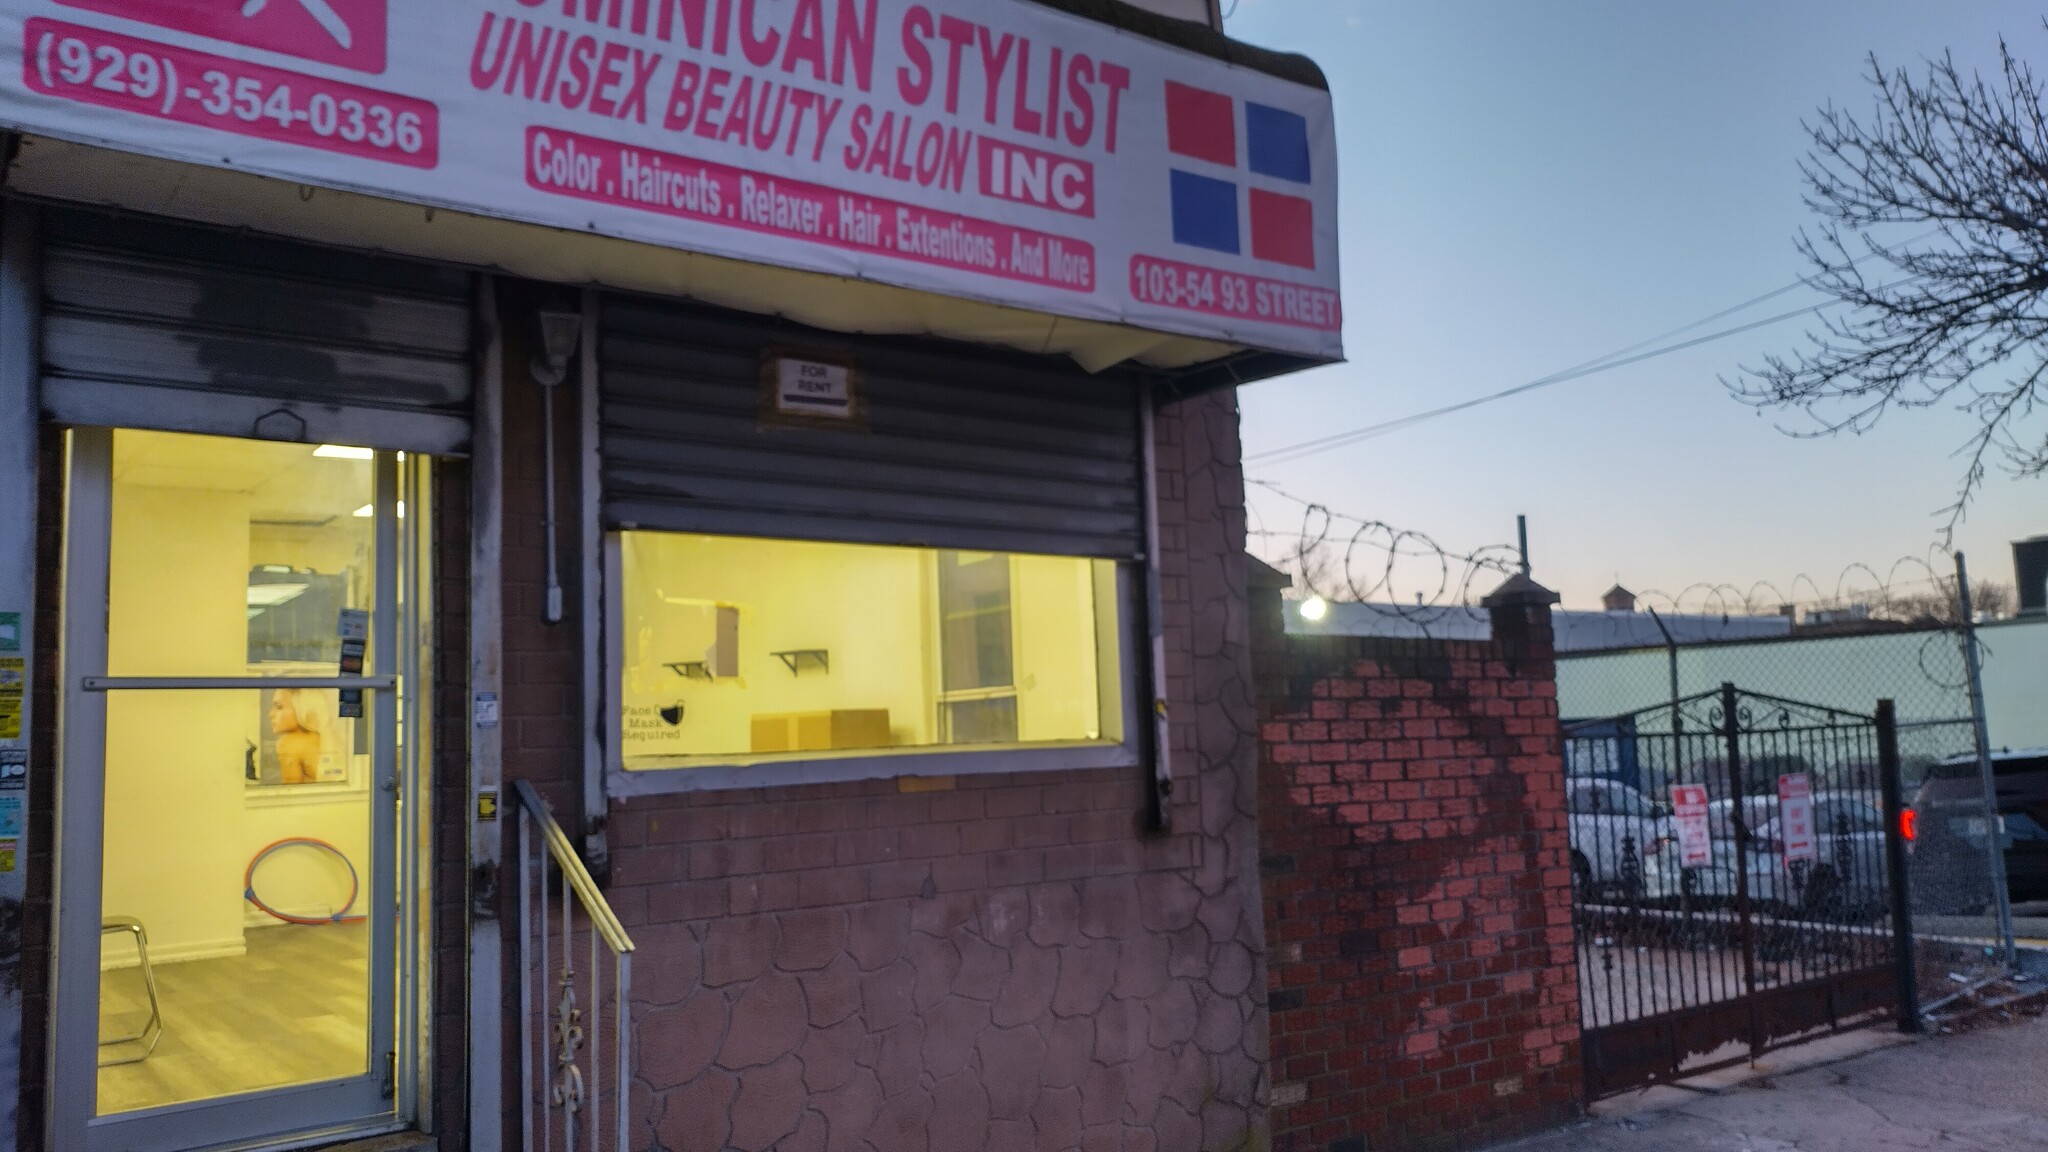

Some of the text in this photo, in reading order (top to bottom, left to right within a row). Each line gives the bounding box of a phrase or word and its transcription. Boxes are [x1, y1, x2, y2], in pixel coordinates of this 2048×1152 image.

[36, 32, 423, 153] (929)-354-0336
[897, 5, 1130, 154] STYLIST
[469, 11, 1086, 211] UNISEX BEAUTY SALON INC
[533, 131, 1091, 288] Color Haircuts Relaxer Hair Extentions And More
[1135, 262, 1336, 326] 103-54 93 STREET
[798, 379, 832, 393] RENT
[800, 364, 828, 378] FOR
[622, 704, 652, 716] Face
[628, 717, 663, 728] Mask
[622, 729, 681, 741] Required
